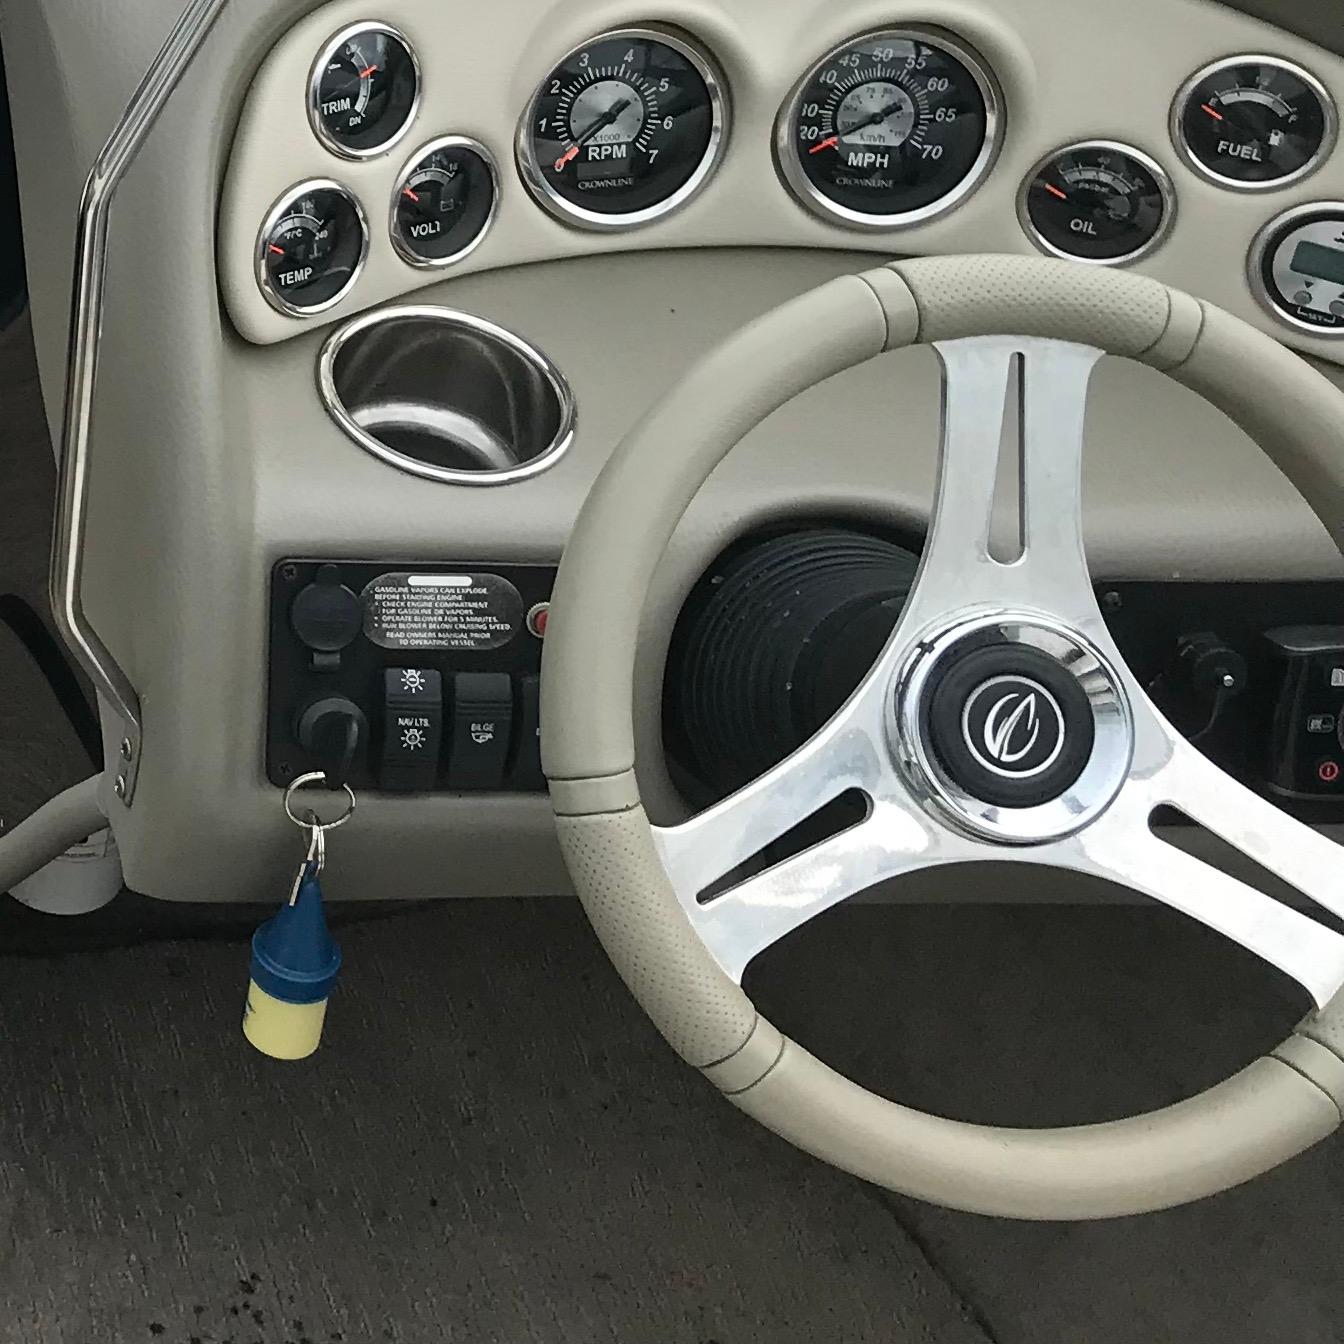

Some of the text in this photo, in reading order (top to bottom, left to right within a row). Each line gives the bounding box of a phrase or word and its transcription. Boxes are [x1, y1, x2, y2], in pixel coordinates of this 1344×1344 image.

[579, 53, 589, 67] 3
[624, 49, 634, 63] 4
[838, 54, 860, 67] 45
[871, 48, 893, 62] 50
[905, 55, 926, 70] 55
[551, 80, 561, 94] 2
[659, 78, 670, 92] 5
[927, 77, 949, 91] 60
[322, 98, 351, 115] TRIM
[349, 116, 361, 126] DN
[664, 115, 674, 130] 6
[935, 107, 957, 123] 65
[539, 118, 547, 133] 1
[588, 144, 627, 160] RPM
[648, 150, 658, 165] 7
[921, 145, 943, 161] 70
[1217, 140, 1262, 162] FUEL
[848, 152, 889, 168] MPH
[577, 177, 634, 190] CROWNLINE
[836, 176, 894, 188] CROWNLINE
[411, 221, 440, 237] VOLT
[1070, 218, 1096, 235] OIL
[279, 267, 312, 286] TEMP
[409, 638, 448, 646] OPERATING
